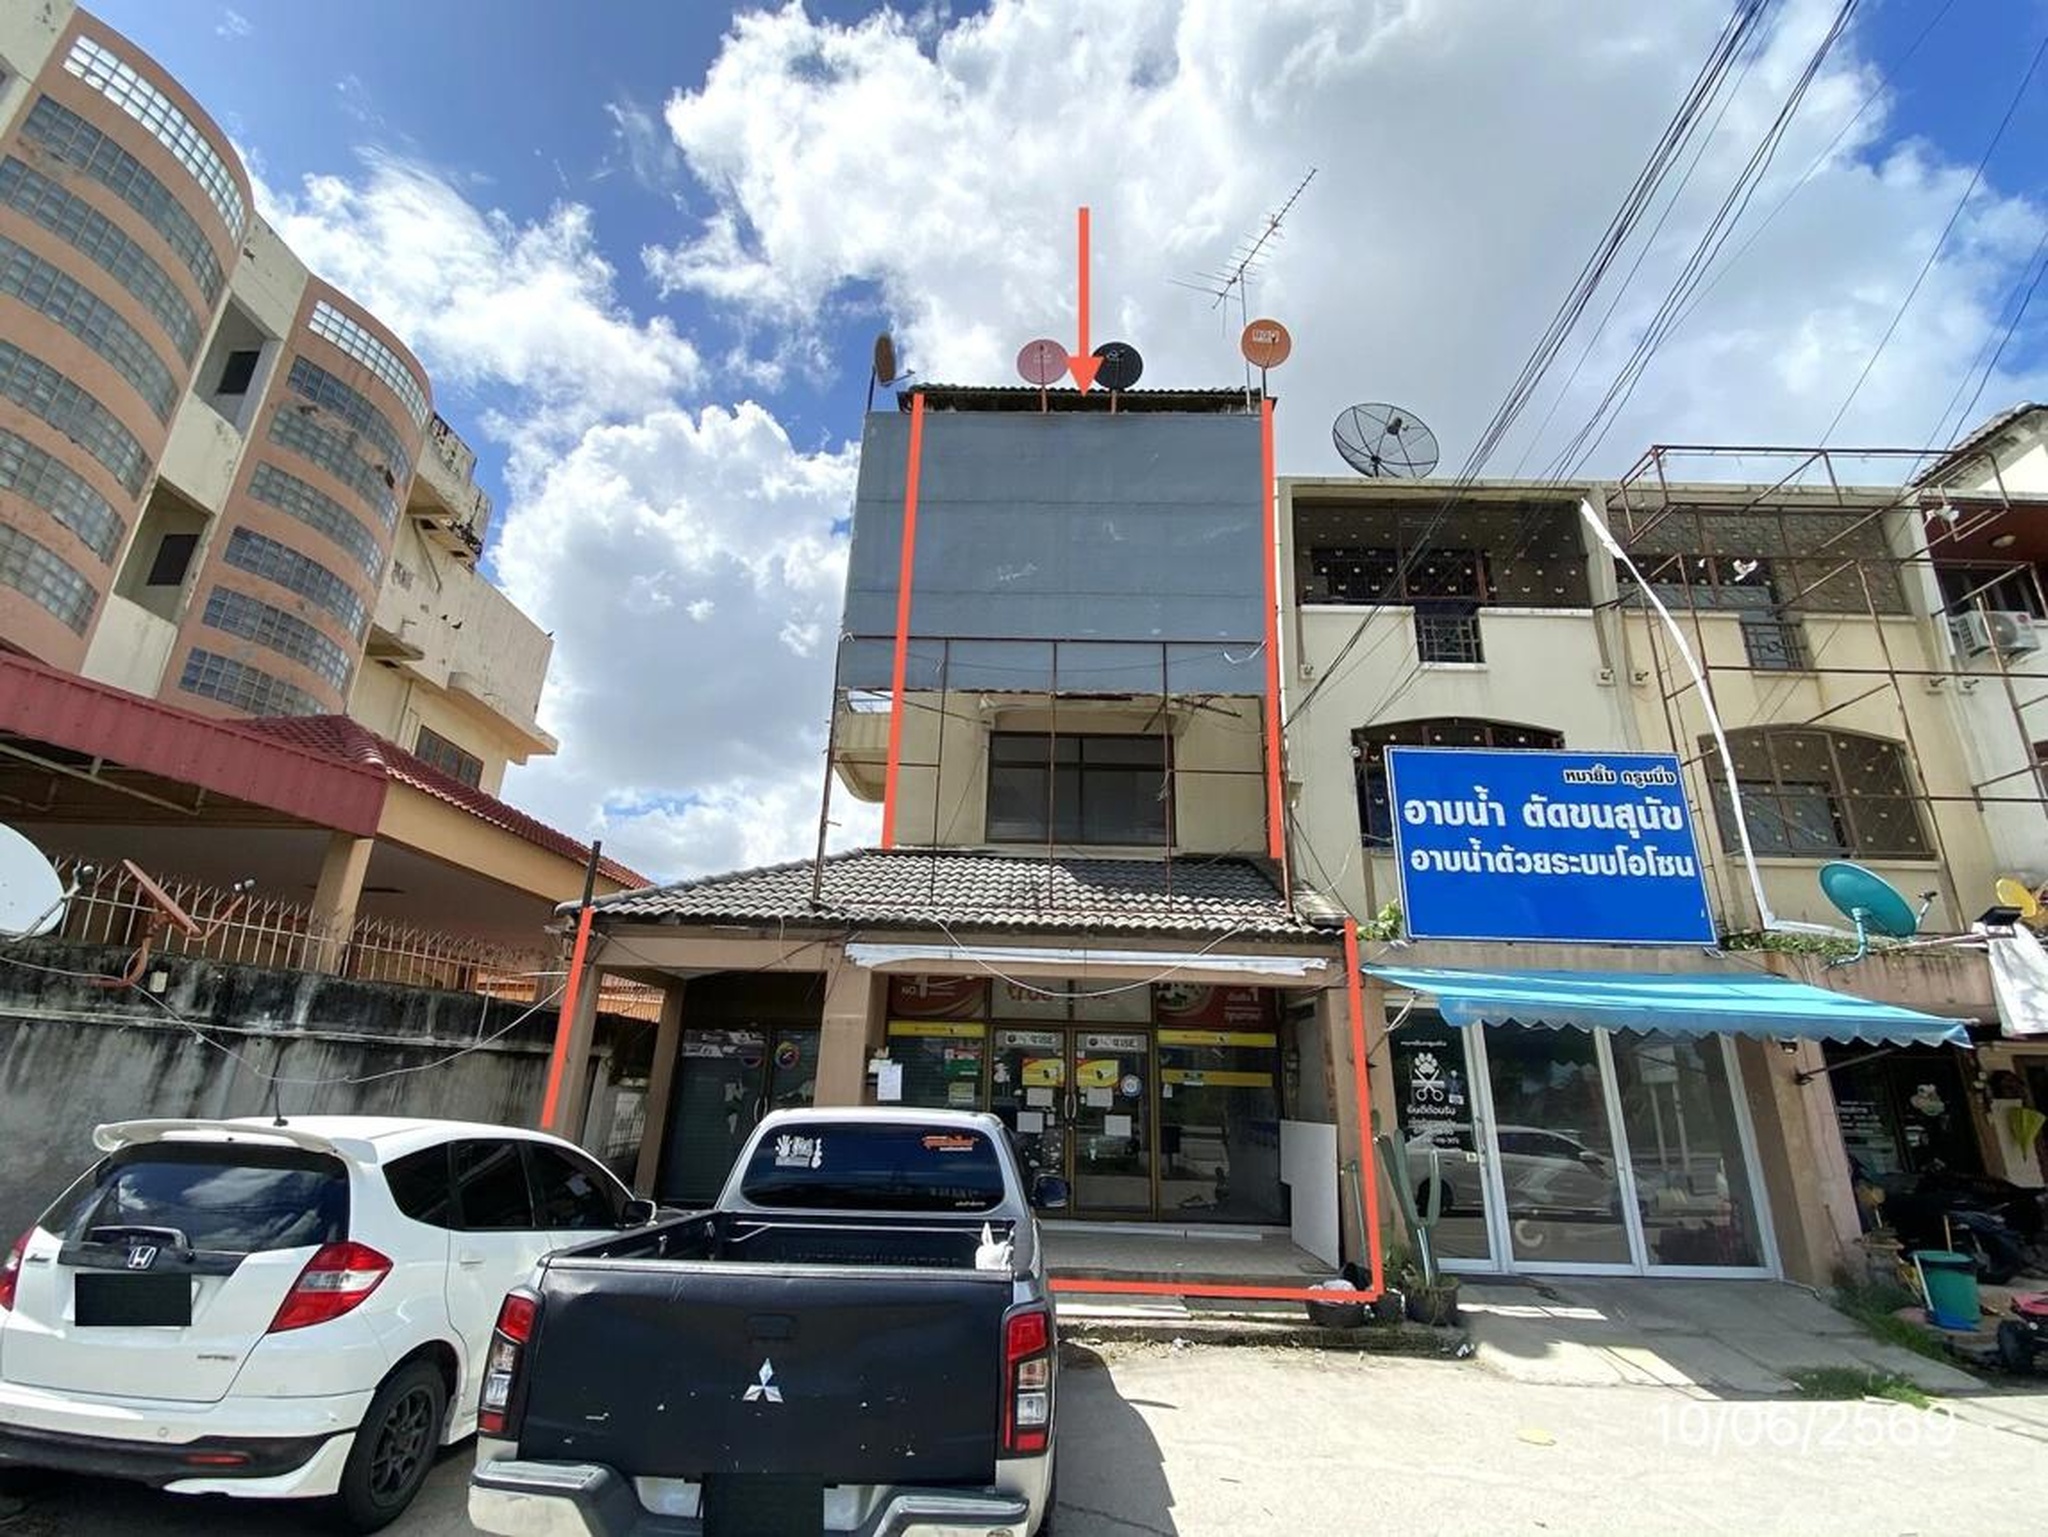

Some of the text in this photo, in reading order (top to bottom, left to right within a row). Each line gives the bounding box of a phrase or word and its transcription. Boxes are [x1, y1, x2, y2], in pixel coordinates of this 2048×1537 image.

[1404, 786, 1683, 840] อาบน้ำ ตัดขนสุนัข
[1411, 838, 1696, 877] อาบน้ำด้วยระบบโอโซน
